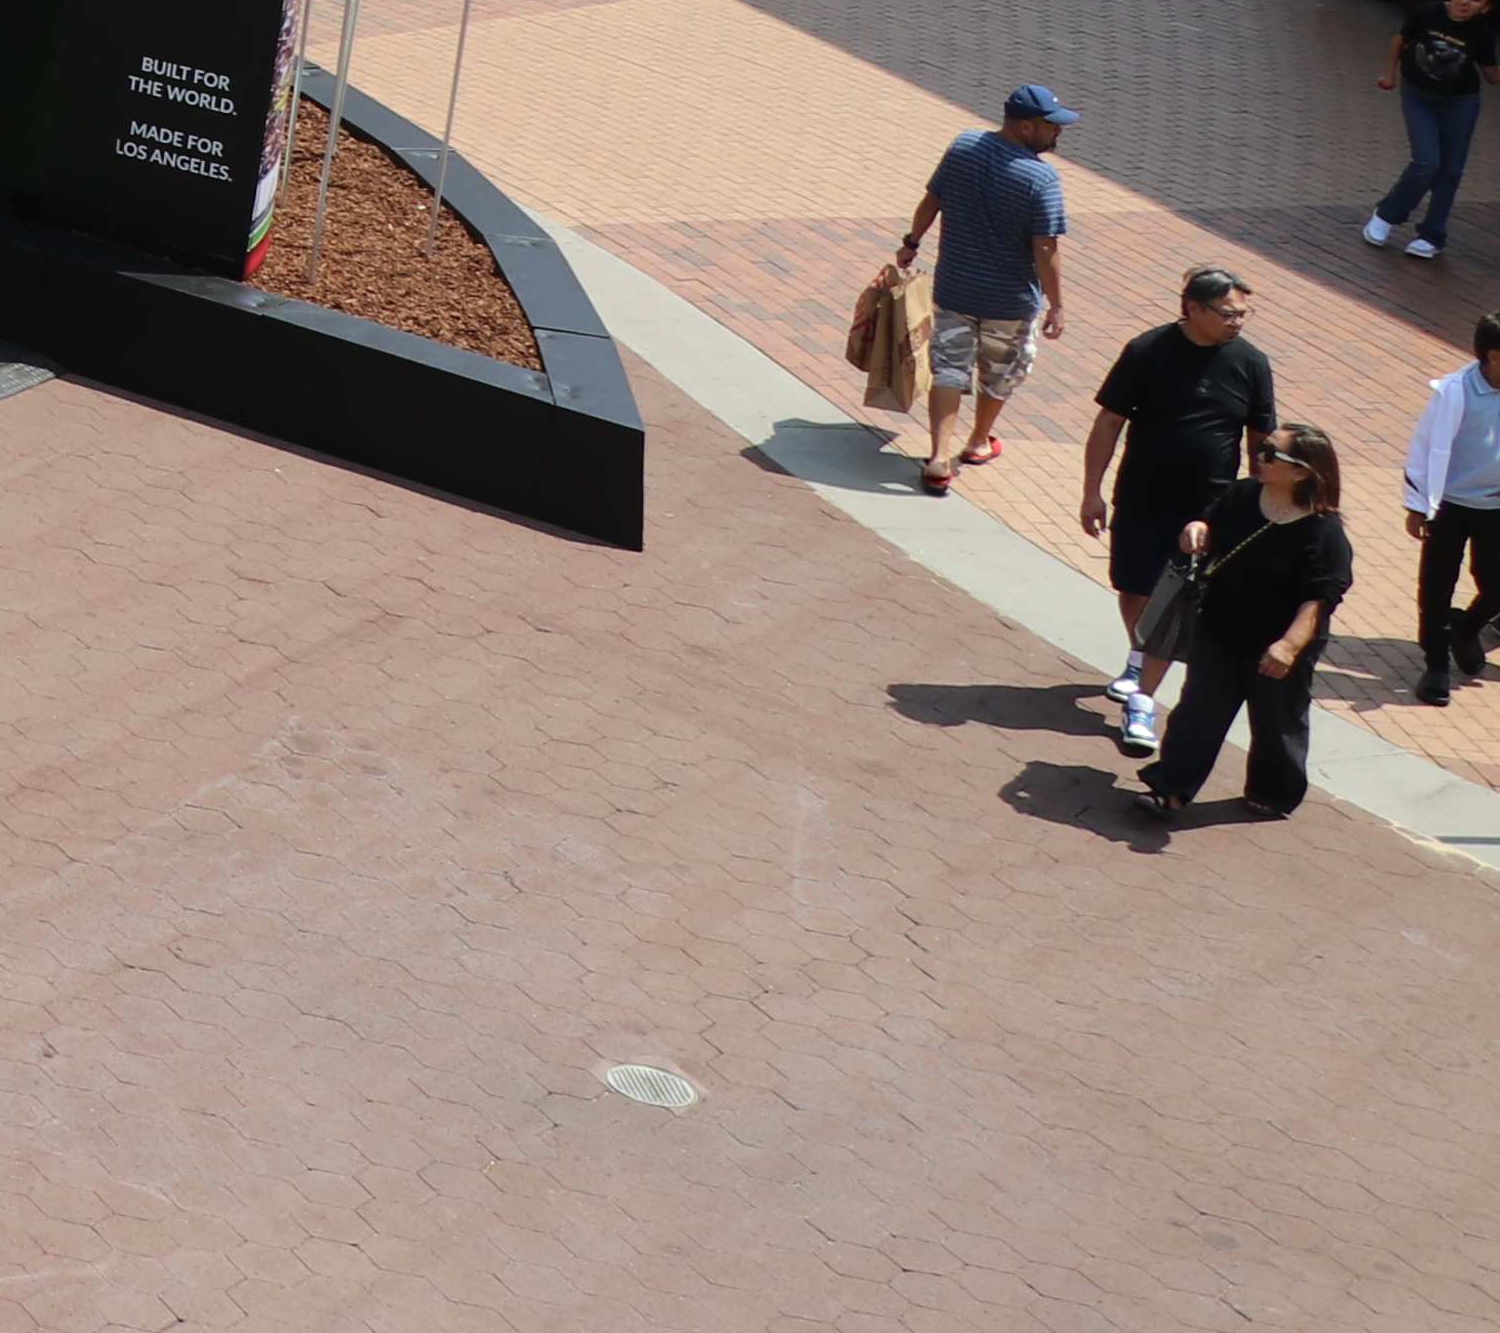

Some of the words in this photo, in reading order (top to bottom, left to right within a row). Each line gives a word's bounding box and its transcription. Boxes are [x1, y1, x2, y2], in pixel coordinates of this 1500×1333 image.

[141, 56, 192, 81] BUILT
[193, 69, 231, 91] FOR
[128, 74, 164, 98] THE
[166, 84, 238, 116] WORLD.
[130, 120, 185, 148] MADE
[187, 134, 224, 158] FOR
[115, 138, 148, 161] LOS
[149, 148, 233, 183] ANGELES.
